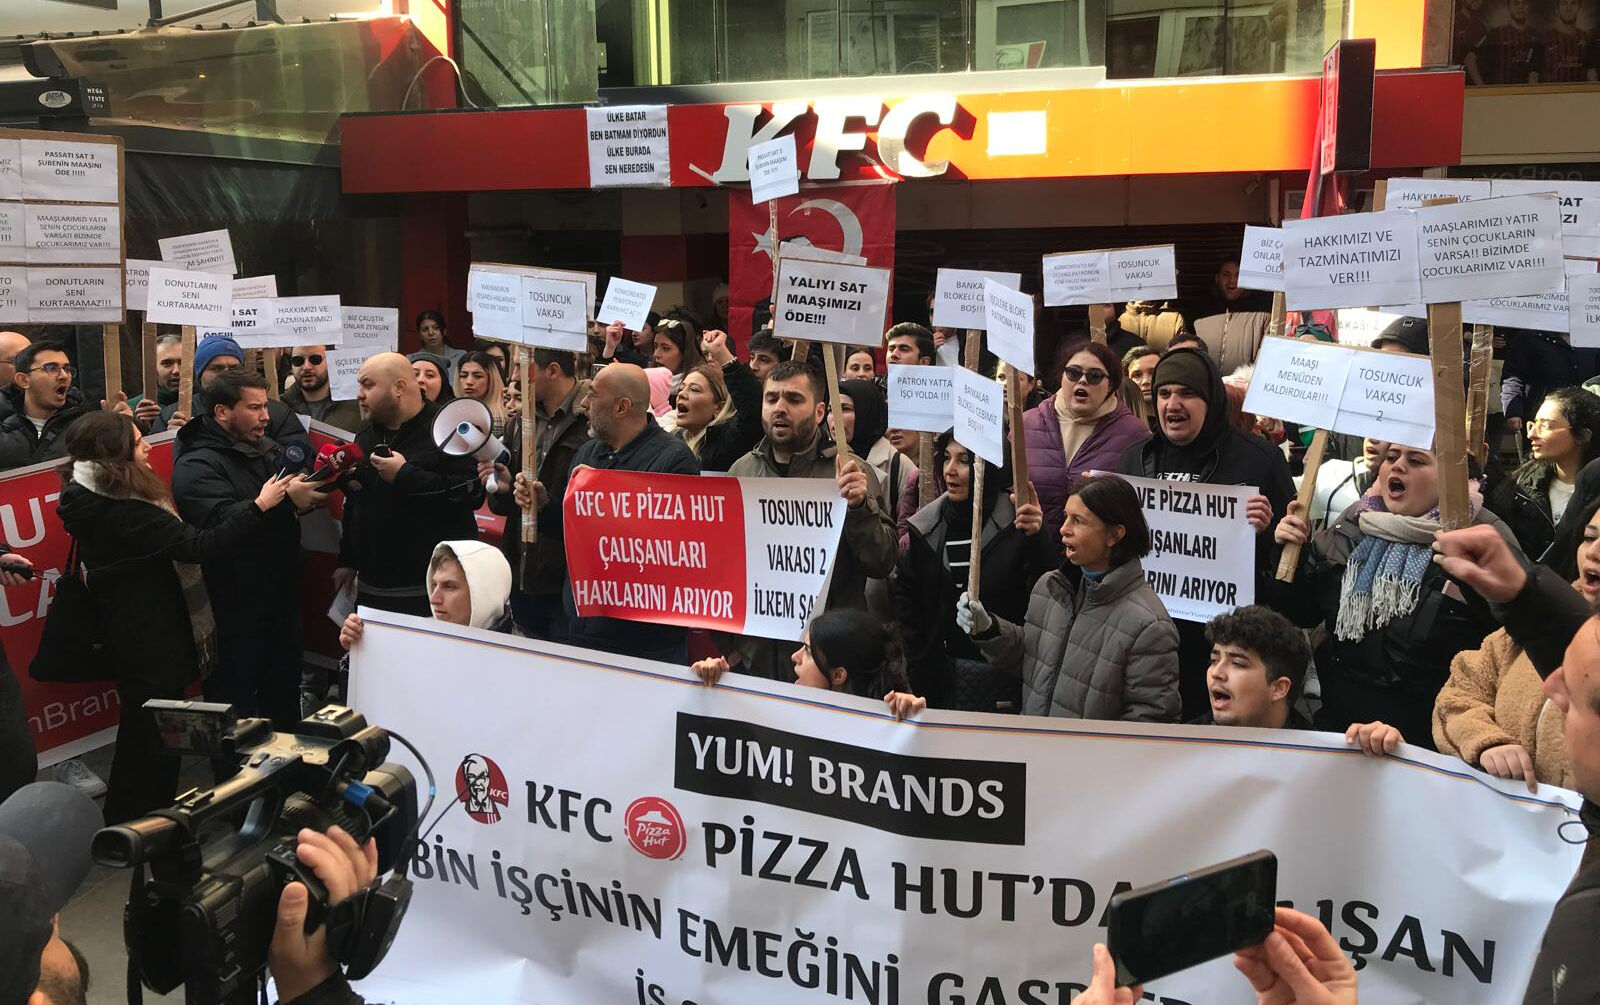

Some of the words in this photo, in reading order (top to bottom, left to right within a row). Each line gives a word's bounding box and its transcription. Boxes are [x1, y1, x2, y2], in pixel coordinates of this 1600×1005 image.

[606, 111, 624, 122] ÜLKE
[626, 112, 647, 122] BATAR
[590, 131, 604, 140] BEN
[604, 129, 632, 140] BATMAM
[712, 94, 962, 182] KFC
[606, 146, 624, 157] ÜLKE
[626, 146, 652, 156] BURADA
[70, 161, 102, 169] MAAŞINI
[604, 164, 618, 174] SEN
[618, 162, 655, 174] NEREDESİN
[62, 224, 106, 232] ÇOCUKLARIN
[1422, 217, 1503, 234] MAAŞLARIMIZI
[1506, 213, 1539, 224] YATIR
[1261, 239, 1273, 247] BİZ
[1304, 232, 1372, 249] HAKKIMIZI
[1376, 230, 1393, 242] VE
[1427, 236, 1459, 248] SENİN
[1463, 228, 1535, 246] ÇOCUKLARIN
[1254, 251, 1281, 260] ONLAR
[1298, 249, 1401, 268] TAZMİNATIMIZI
[1434, 247, 1479, 262] VARSA!!
[1482, 243, 1530, 257] BİZİMDE
[1117, 259, 1160, 269] TOSUNCUK
[1265, 265, 1284, 273] OLD
[1422, 260, 1506, 278] ÇOCUKLARIMIZ
[1508, 257, 1545, 269] VAR!!!
[45, 278, 104, 286] DONUTLARIN
[1125, 272, 1153, 280] VAKASI
[1329, 271, 1370, 284] VER!!!
[165, 279, 218, 290] DONUTLARIN
[789, 276, 835, 290] YALIYI
[839, 281, 868, 294] SAT
[956, 281, 984, 289] BANKA
[65, 288, 86, 296] SENİ
[529, 291, 572, 304] TOSUNCUK
[40, 299, 112, 307] KURTARAMAZ!!!
[157, 300, 222, 312] KURTARAMAZ!!!
[786, 293, 861, 311] MAAŞIMIZI
[1489, 300, 1551, 311] ÇOCUKLARIMIZ
[278, 306, 316, 314] HAKKIMIZI
[536, 307, 564, 319] VAKASI
[784, 309, 826, 325] ÖDE!!!
[293, 326, 317, 334] VER!!!
[548, 324, 553, 333] 2
[1290, 356, 1319, 373] MAAŞI
[898, 377, 927, 386] PATRON
[929, 379, 953, 387] YATTA
[1278, 370, 1323, 386] MENÜDEN
[1359, 368, 1424, 388] TOSUNCUK
[900, 389, 914, 400] İŞÇİ
[1263, 382, 1329, 404] KALDIRDILAR!!!
[1365, 388, 1406, 405] VAKASI
[1375, 410, 1384, 422] 2
[575, 491, 604, 518] KFC
[609, 491, 631, 518] VE
[637, 487, 686, 521] PİZZA
[690, 495, 725, 522] HUT
[1136, 486, 1155, 509] VE
[1160, 485, 1202, 516] PİZZA
[1206, 494, 1238, 519] HUT
[758, 498, 833, 528] TOSUNCUK
[598, 535, 708, 574] ÇALIŞANLARI
[766, 543, 815, 575] VAKASI
[819, 548, 826, 575] 2
[1143, 570, 1177, 596] RINI
[1180, 576, 1237, 606] ARIYOR
[575, 579, 666, 612] HAKLARINI
[672, 586, 733, 620] ARIYOR
[754, 583, 794, 618] İLKEM
[799, 592, 820, 630] ŞA
[688, 732, 794, 787] YUM!
[808, 755, 1005, 819] BRANDS
[489, 788, 508, 800] KFC
[636, 823, 671, 837] Pizza
[643, 835, 670, 847] Hut
[525, 780, 613, 843] KFC
[701, 815, 870, 900] PİZZA
[1277, 899, 1496, 984] IŞAN
[411, 834, 479, 891] BİN
[491, 850, 662, 940] İŞÇİNİN
[677, 907, 900, 1005] EMEĞİNİ
